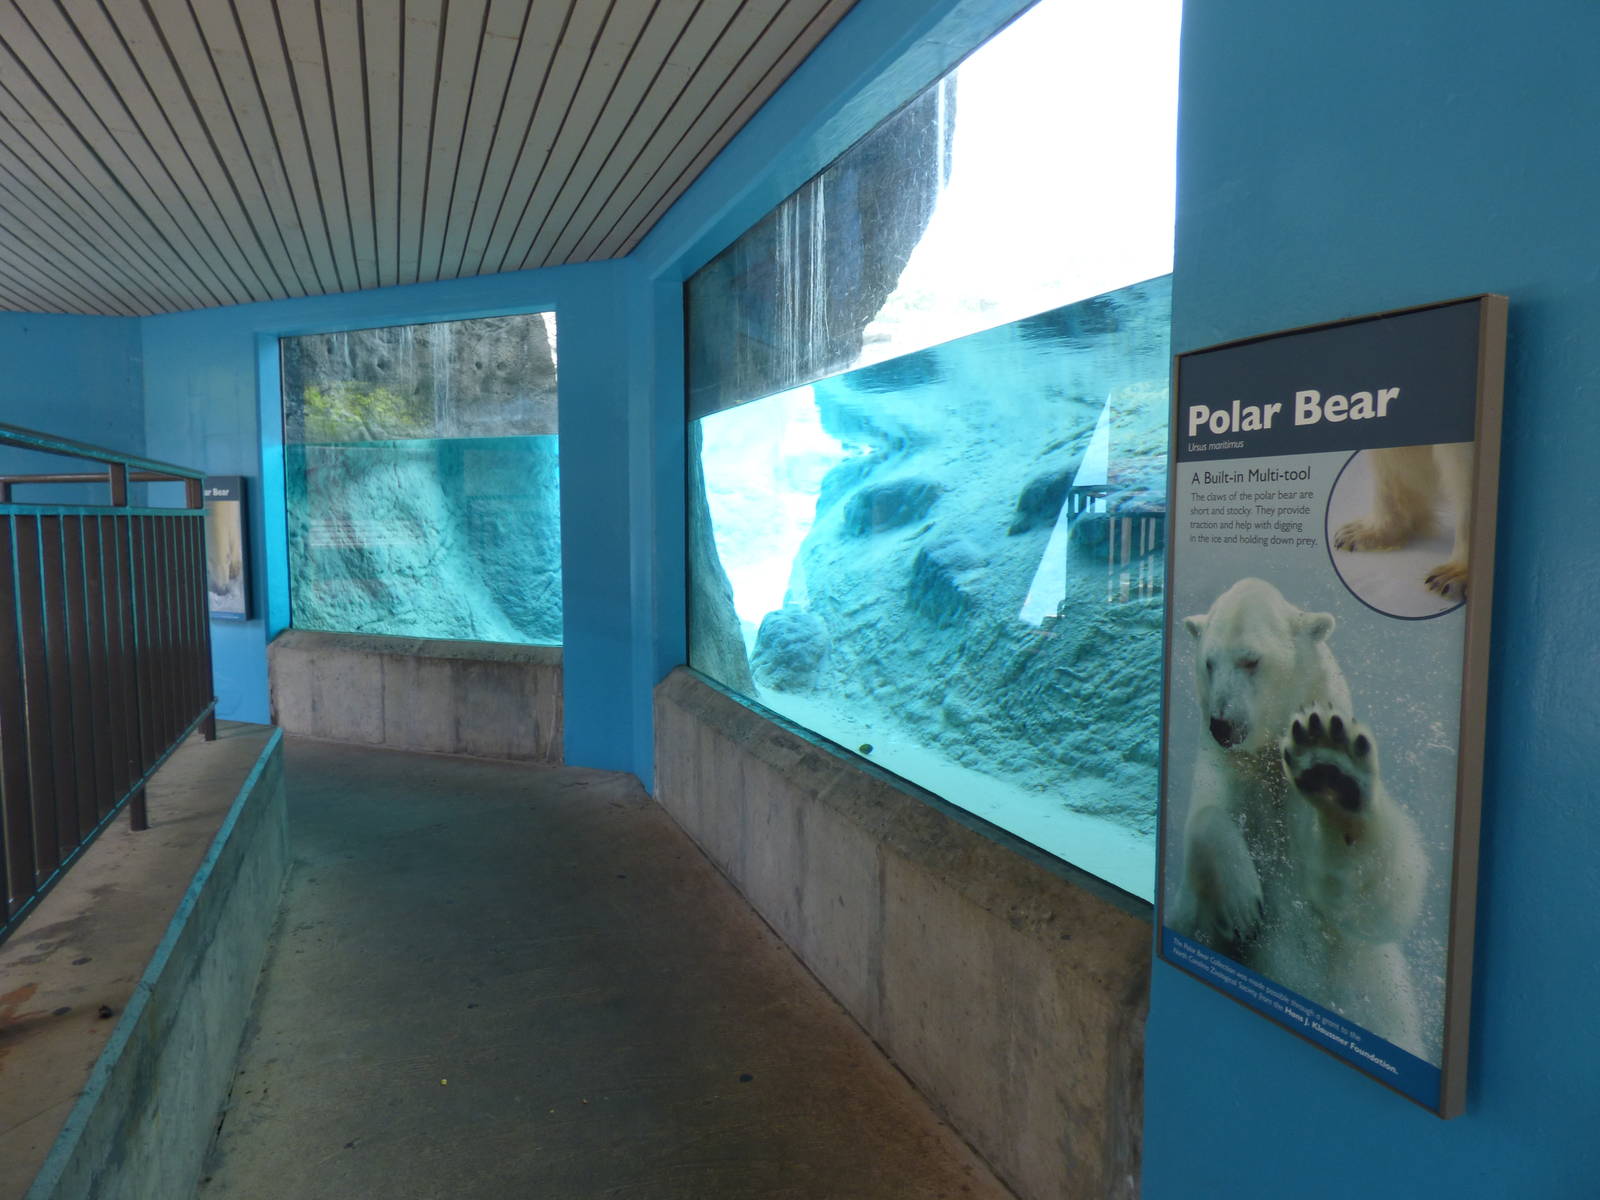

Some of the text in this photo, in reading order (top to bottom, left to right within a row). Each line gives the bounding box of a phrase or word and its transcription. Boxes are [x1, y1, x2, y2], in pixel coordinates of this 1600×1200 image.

[1188, 387, 1400, 437] Polar Bear
[1188, 440, 1244, 452] Ursus maritimus
[1191, 465, 1311, 485] A Built-in Multi-tool
[212, 488, 230, 497] Bear
[1192, 490, 1314, 502] The claws of the polar bear are
[1190, 506, 1209, 515] short
[1211, 506, 1225, 515] and
[1256, 505, 1275, 516] They
[1277, 505, 1311, 516] provide
[1190, 520, 1303, 532] traction and help with digging
[1190, 534, 1196, 543] in
[1198, 534, 1209, 543] the
[1211, 535, 1222, 543] ice
[1223, 534, 1237, 543] and
[1239, 535, 1268, 546] holding
[1270, 536, 1294, 545] down
[1284, 1005, 1303, 1023] Hans
